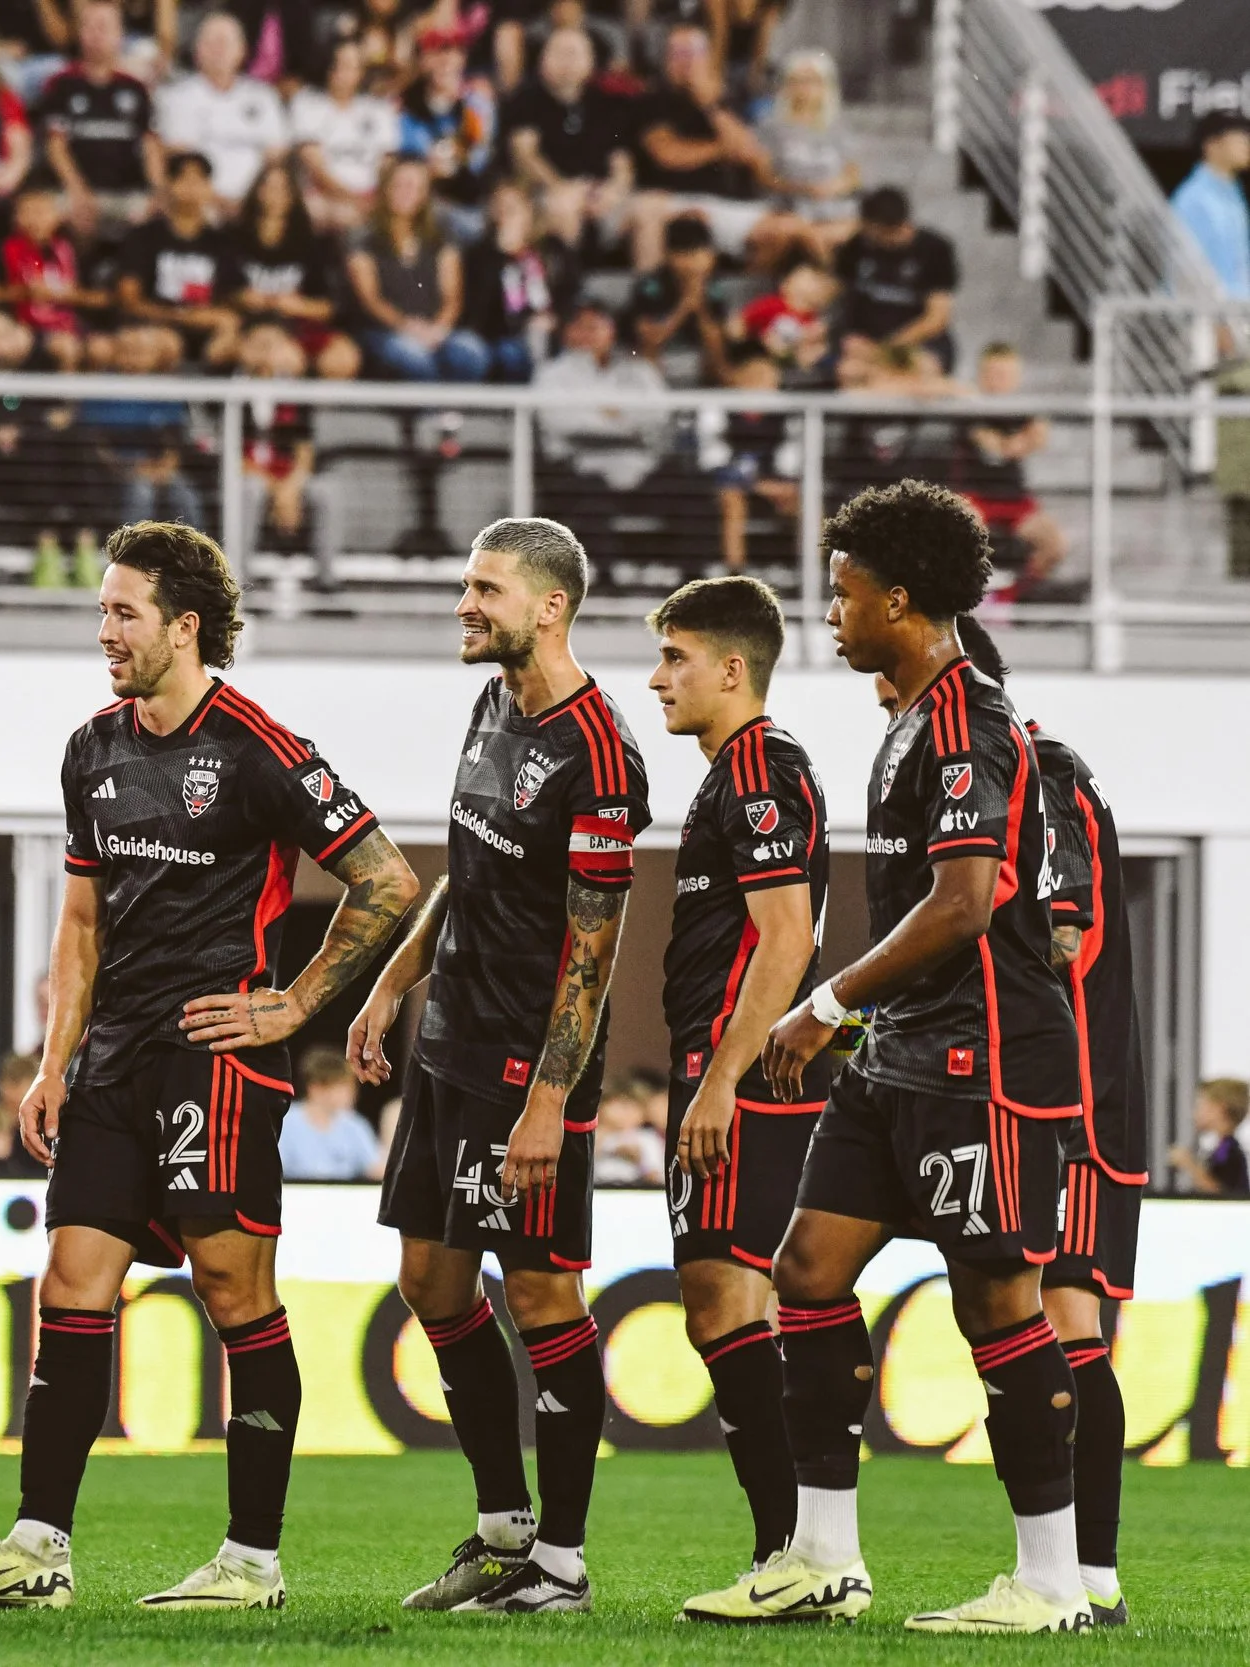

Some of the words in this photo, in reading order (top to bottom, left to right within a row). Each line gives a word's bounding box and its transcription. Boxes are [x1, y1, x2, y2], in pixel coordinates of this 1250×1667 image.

[944, 768, 960, 777] MLS
[305, 774, 320, 787] MLS
[601, 811, 618, 819] MLS
[748, 804, 766, 814] MLS
[451, 800, 525, 859] Guidehouse
[107, 834, 216, 866] Guidehouse
[919, 1143, 988, 1217] 27
